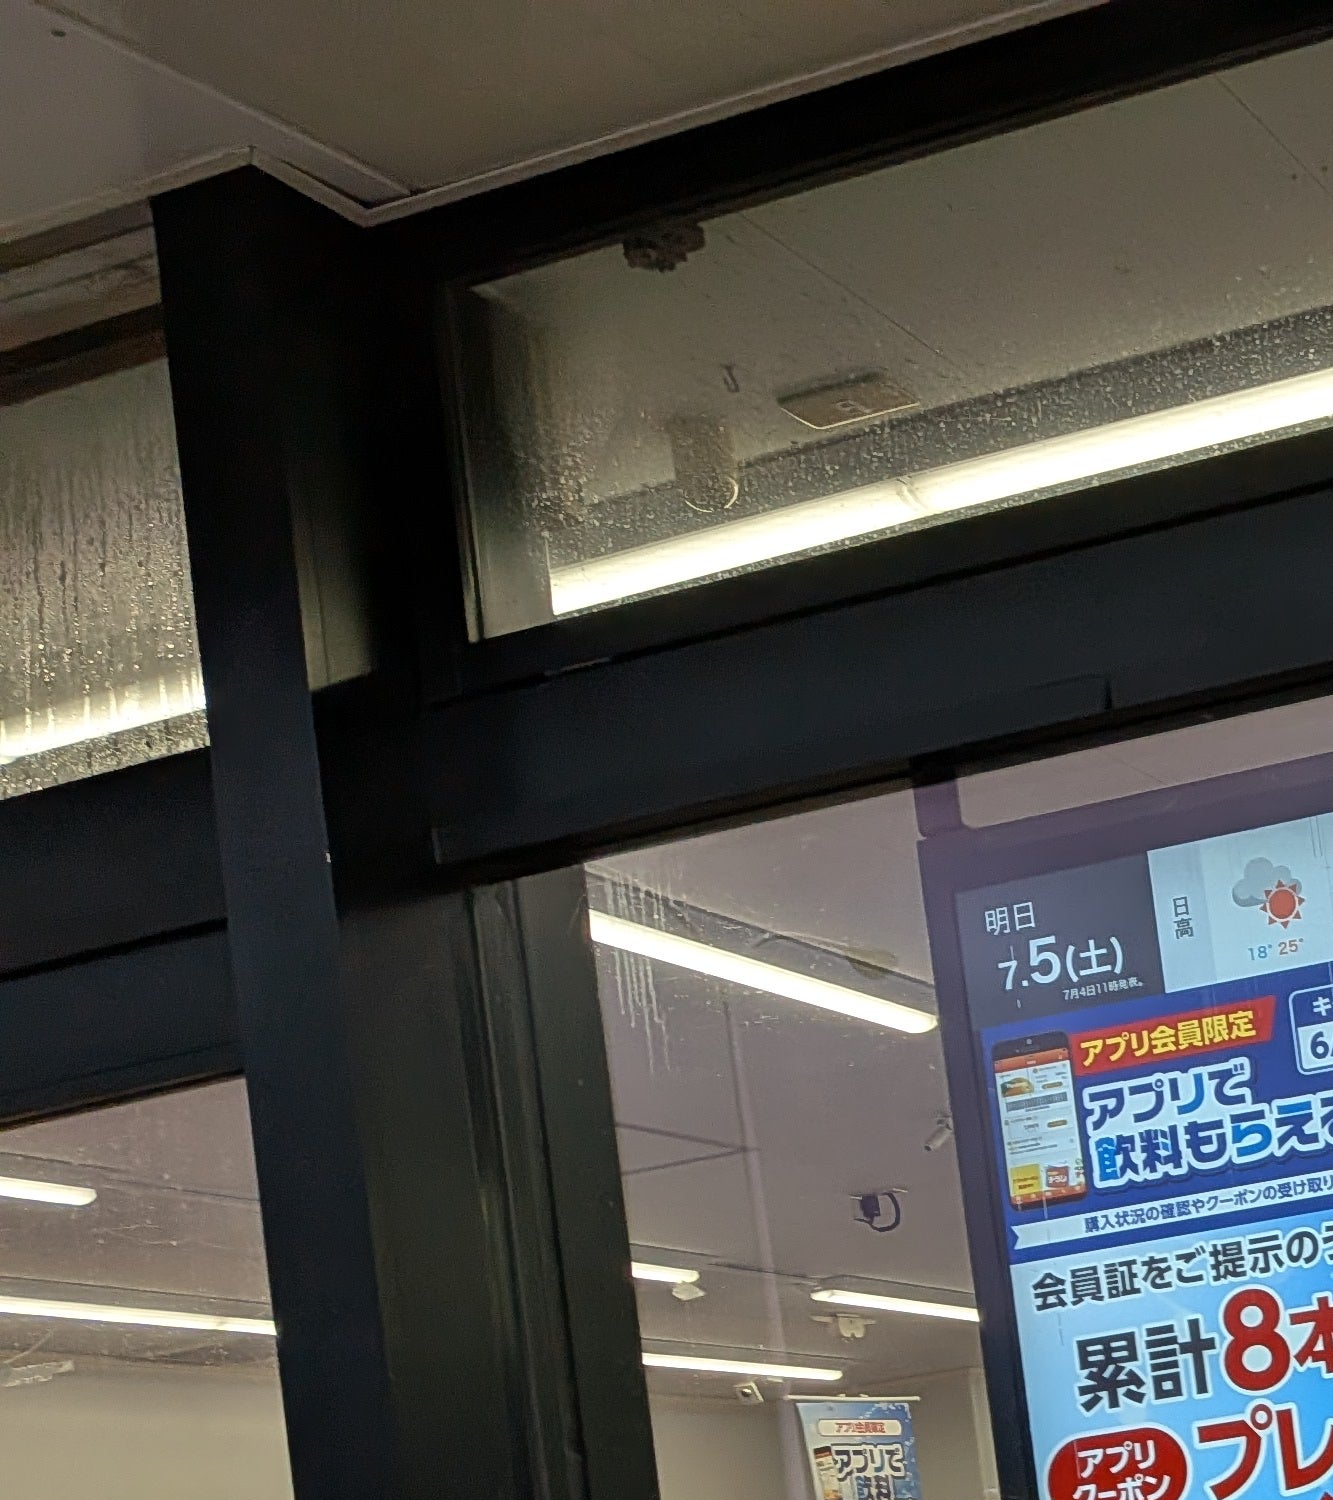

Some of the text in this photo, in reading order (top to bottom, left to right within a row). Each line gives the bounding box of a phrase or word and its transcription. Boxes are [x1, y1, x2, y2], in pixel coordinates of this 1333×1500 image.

[984, 902, 1036, 935] 明日
[1172, 896, 1194, 940] 日高
[998, 935, 1124, 991] 7.5(土)
[1080, 1010, 1257, 1067] アプリ会員限定
[1087, 1061, 1247, 1131] アプリで
[834, 1448, 904, 1474] アプリで
[1077, 1441, 1156, 1479] アプリ
